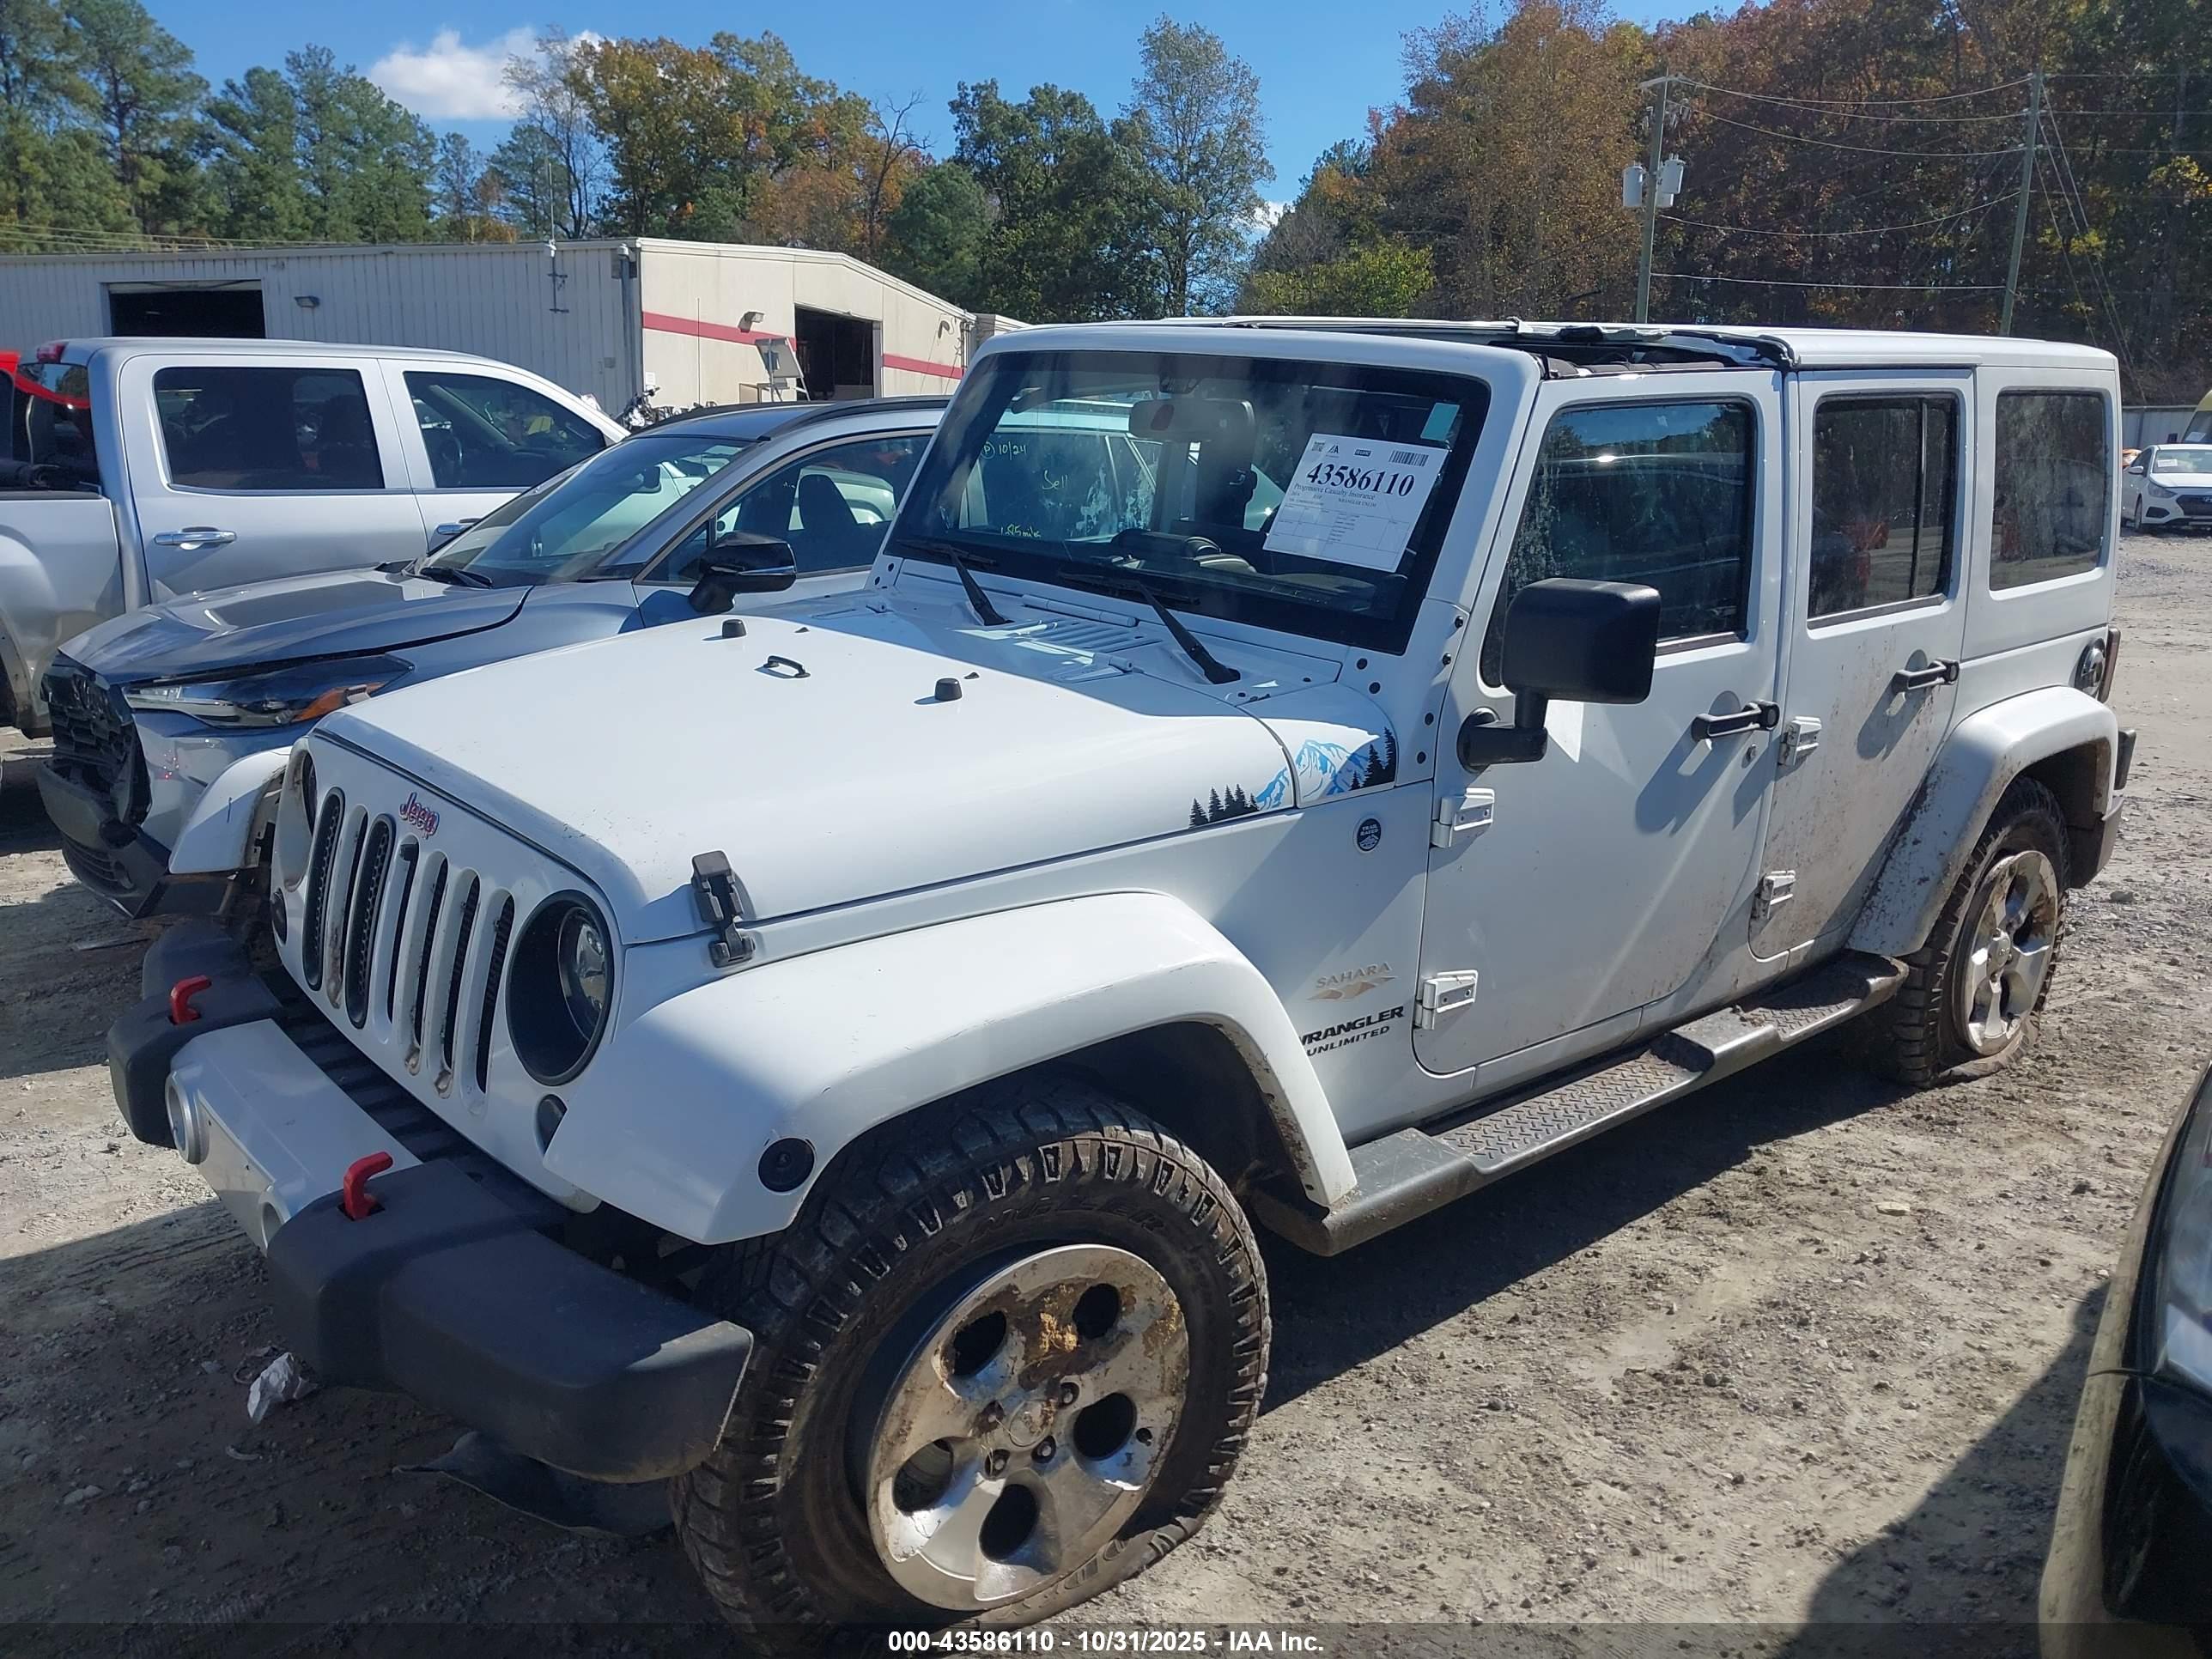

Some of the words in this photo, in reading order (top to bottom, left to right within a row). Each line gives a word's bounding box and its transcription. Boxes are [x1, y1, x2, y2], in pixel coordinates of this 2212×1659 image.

[999, 441, 1027, 460] 10/24
[1042, 470, 1068, 490] Sell
[1306, 462, 1415, 497] 43586110
[1349, 490, 1376, 501] Insurance
[398, 791, 440, 840] Jeep
[1316, 961, 1392, 988] SAHARA
[1306, 1025, 1391, 1056] UNLIMITED
